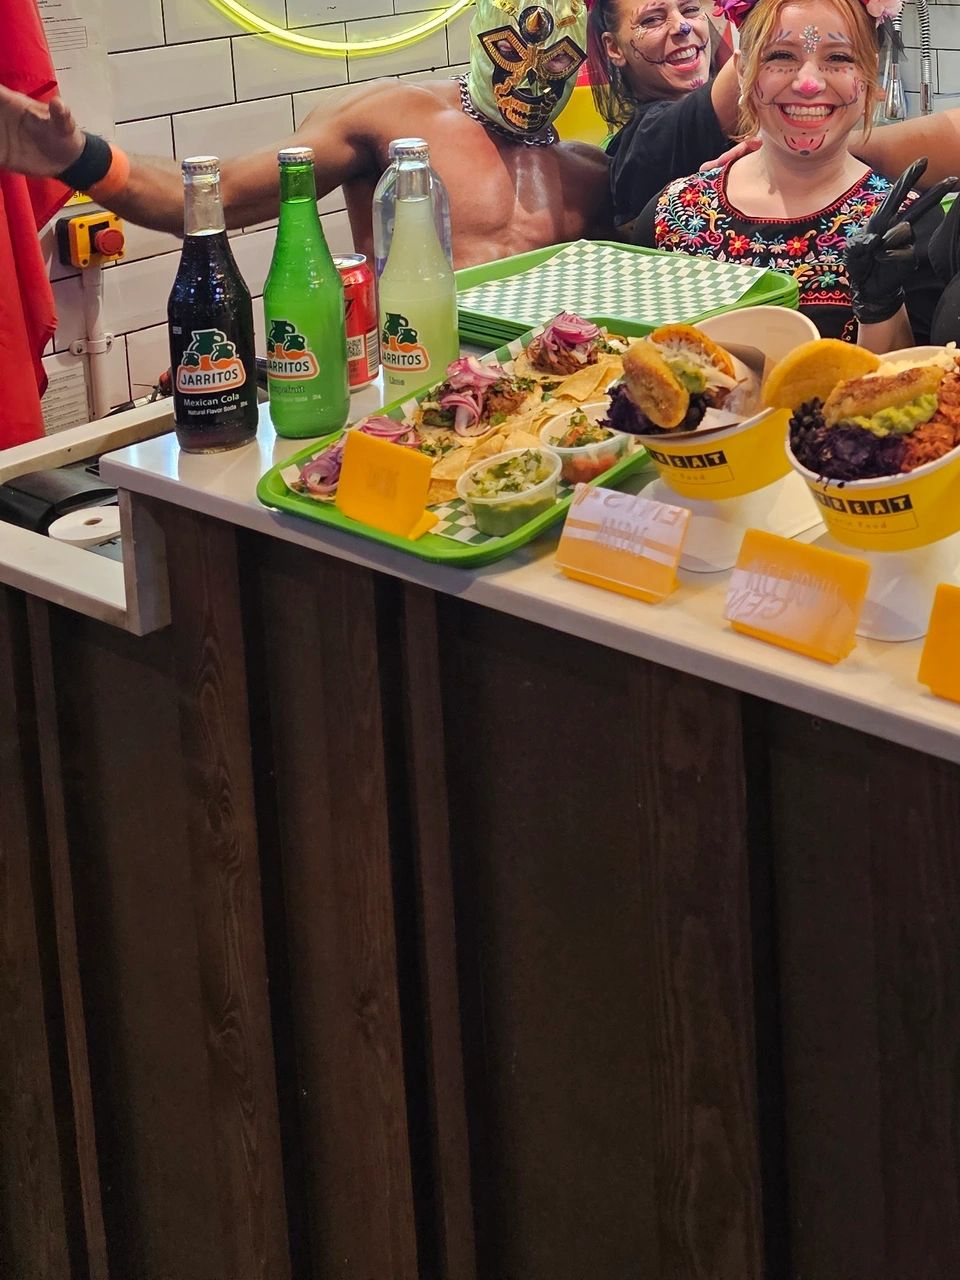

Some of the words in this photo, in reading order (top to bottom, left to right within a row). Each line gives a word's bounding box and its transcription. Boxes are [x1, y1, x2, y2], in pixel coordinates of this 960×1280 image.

[268, 360, 310, 373] ARRITOS
[181, 369, 238, 386] JARRITOS
[184, 398, 219, 407] Mexican
[220, 393, 240, 404] Cola
[206, 407, 223, 415] Flavor
